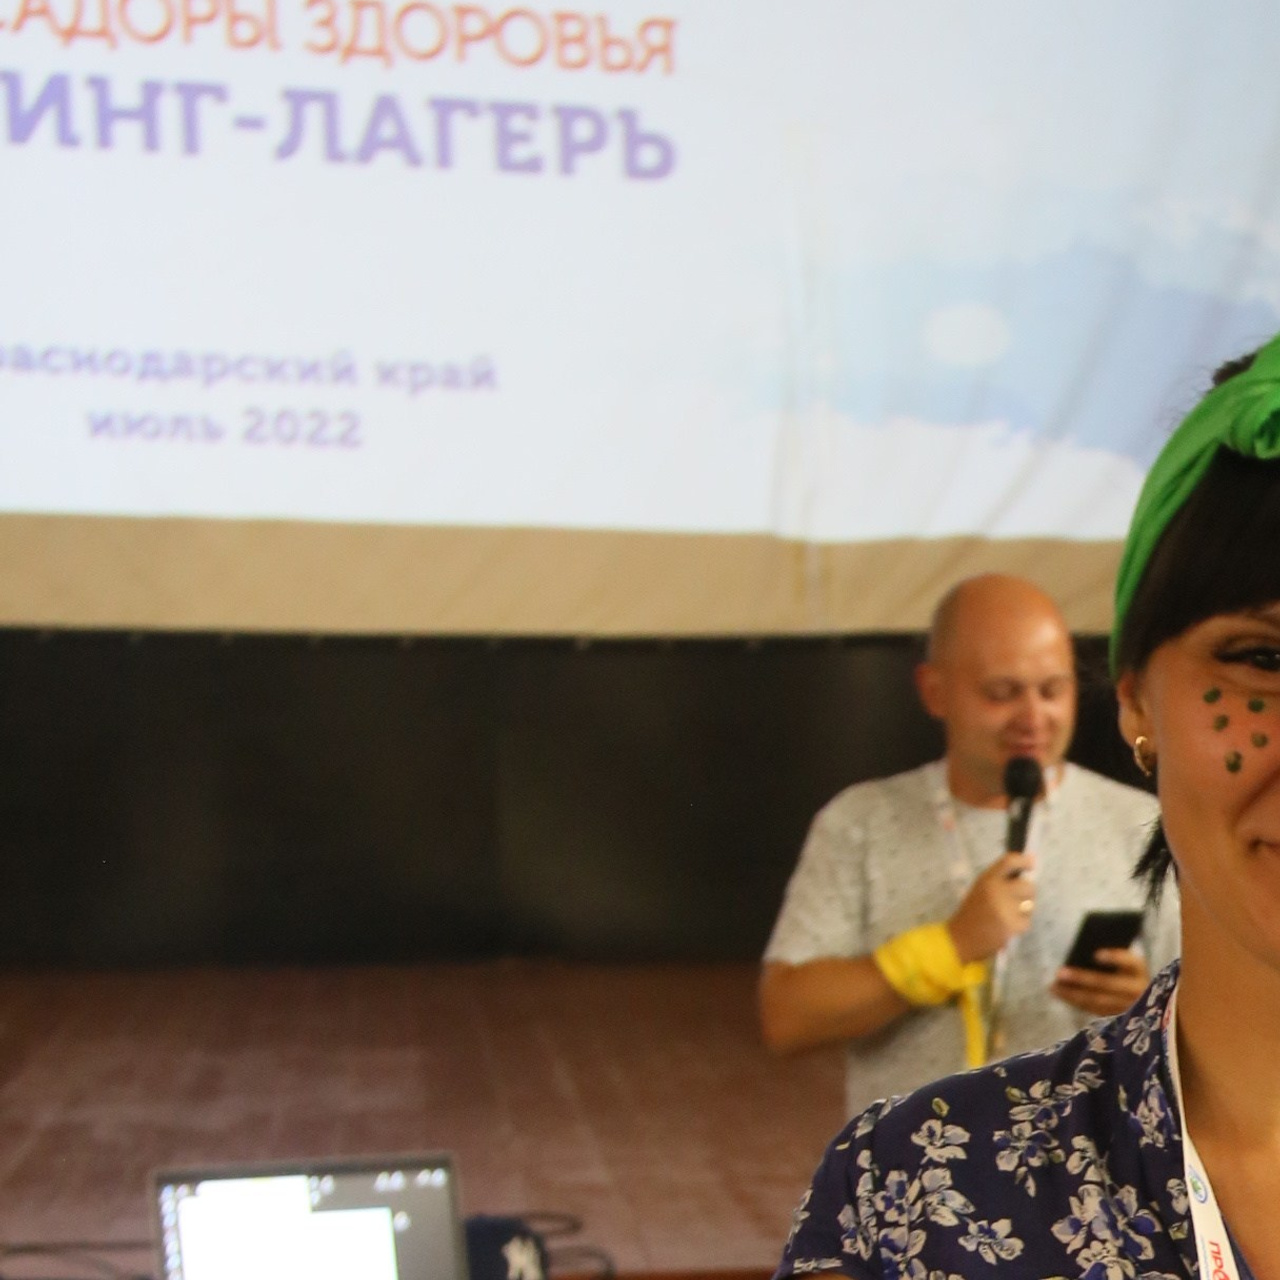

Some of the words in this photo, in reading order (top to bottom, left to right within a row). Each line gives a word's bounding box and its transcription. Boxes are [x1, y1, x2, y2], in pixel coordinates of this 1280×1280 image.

[0, 0, 281, 50] АДОРЫ
[304, 0, 678, 74] ЗДОРОВЬЯ
[0, 70, 677, 181] ИНГ-ЛАГЕРЬ
[0, 345, 358, 386] аснодарский
[375, 350, 498, 394] край
[86, 410, 225, 441] июль
[241, 407, 363, 448] 2022
